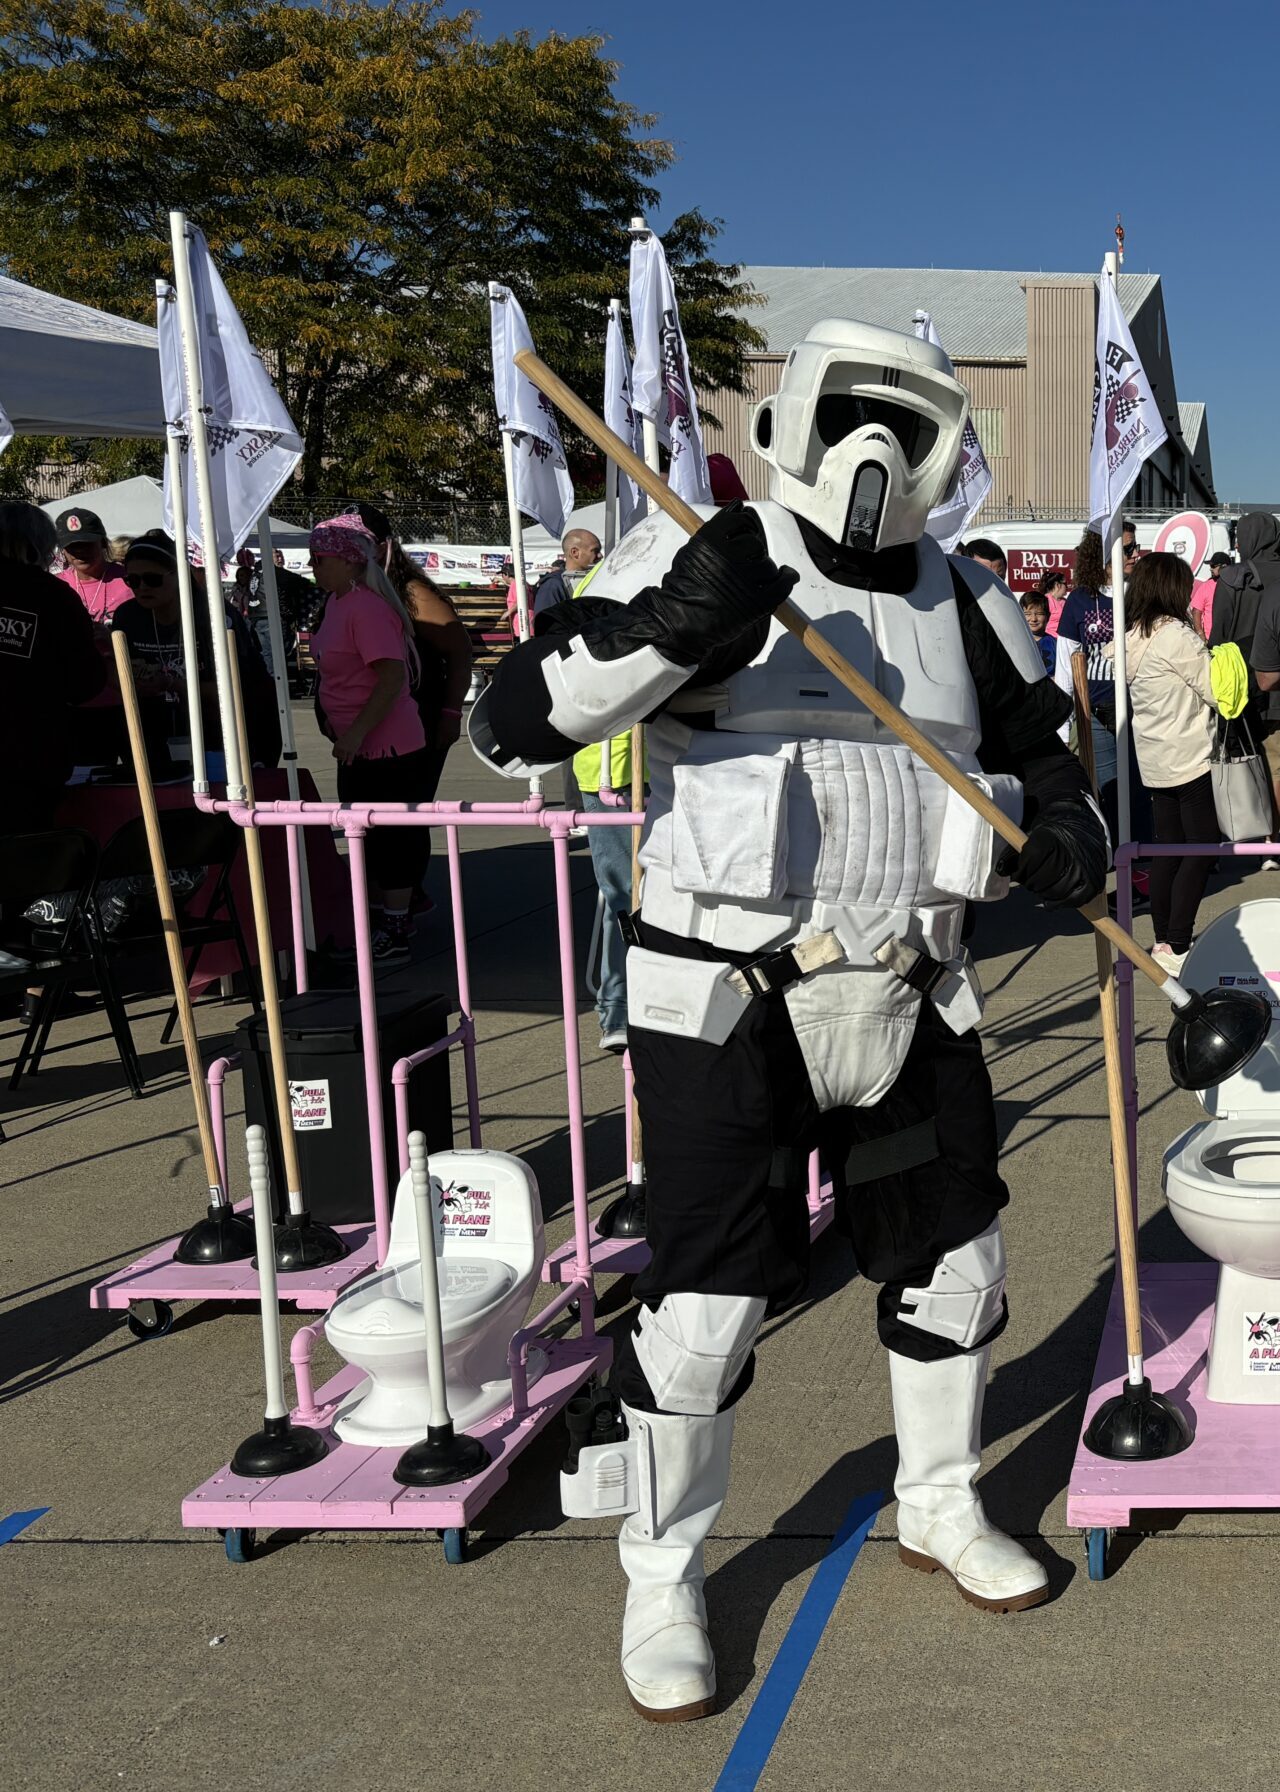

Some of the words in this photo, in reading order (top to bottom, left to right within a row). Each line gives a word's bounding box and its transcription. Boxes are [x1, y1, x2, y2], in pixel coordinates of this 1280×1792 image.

[1021, 551, 1070, 568] PAUL
[303, 1089, 326, 1097] PULL
[293, 1108, 327, 1118] PLANE
[467, 1190, 491, 1200] PULL
[440, 1215, 450, 1225] A
[452, 1215, 491, 1225] PLANE
[1249, 1348, 1260, 1359] A
